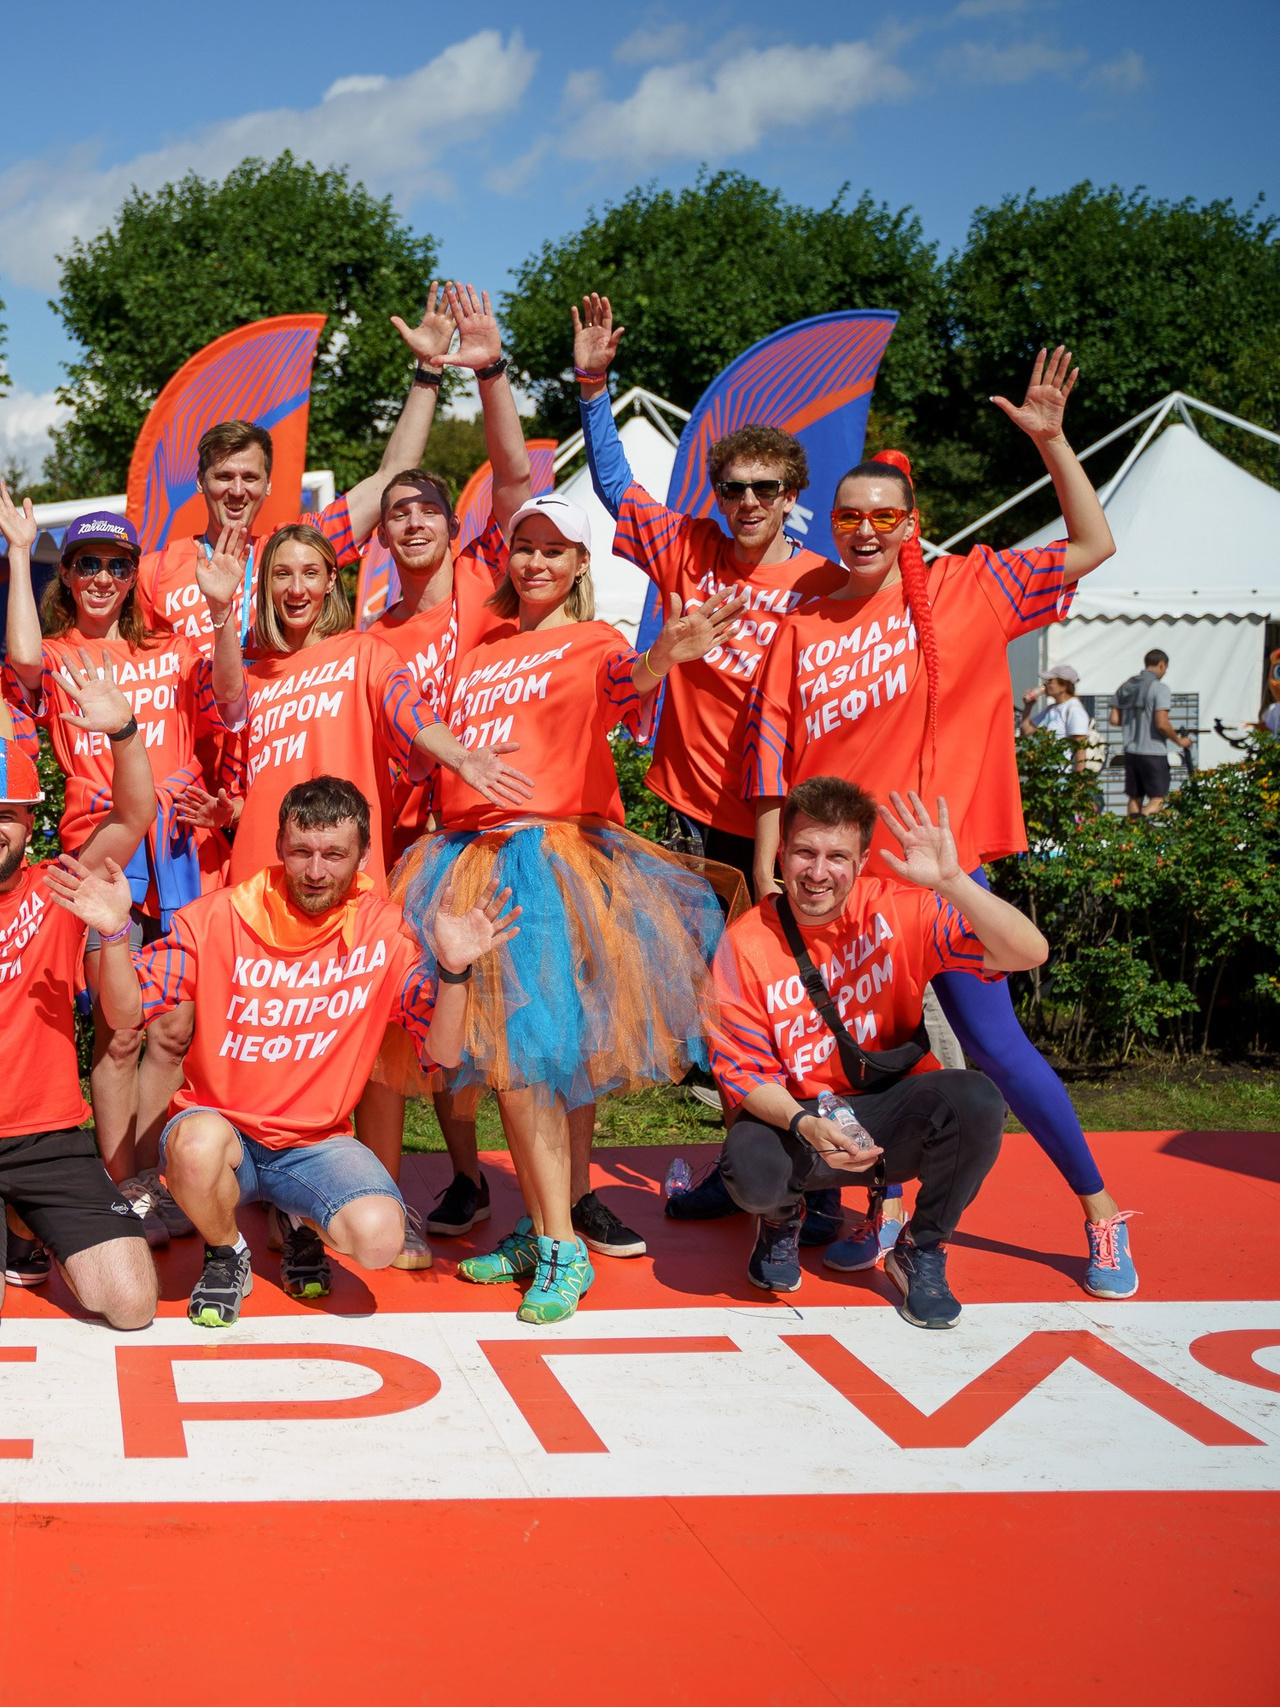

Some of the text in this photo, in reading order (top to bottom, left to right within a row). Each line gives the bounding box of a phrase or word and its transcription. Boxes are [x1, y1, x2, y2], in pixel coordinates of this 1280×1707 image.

[249, 656, 355, 716] ОМАНДА
[805, 664, 907, 744] НЕФТИ
[248, 691, 344, 749] ЗПРОМ
[232, 939, 386, 988] КОМАНДА
[226, 980, 373, 1027] ГАЗПРОМ
[774, 953, 893, 1049] ГАЗРОМ
[219, 1029, 338, 1062] НЕФТИ
